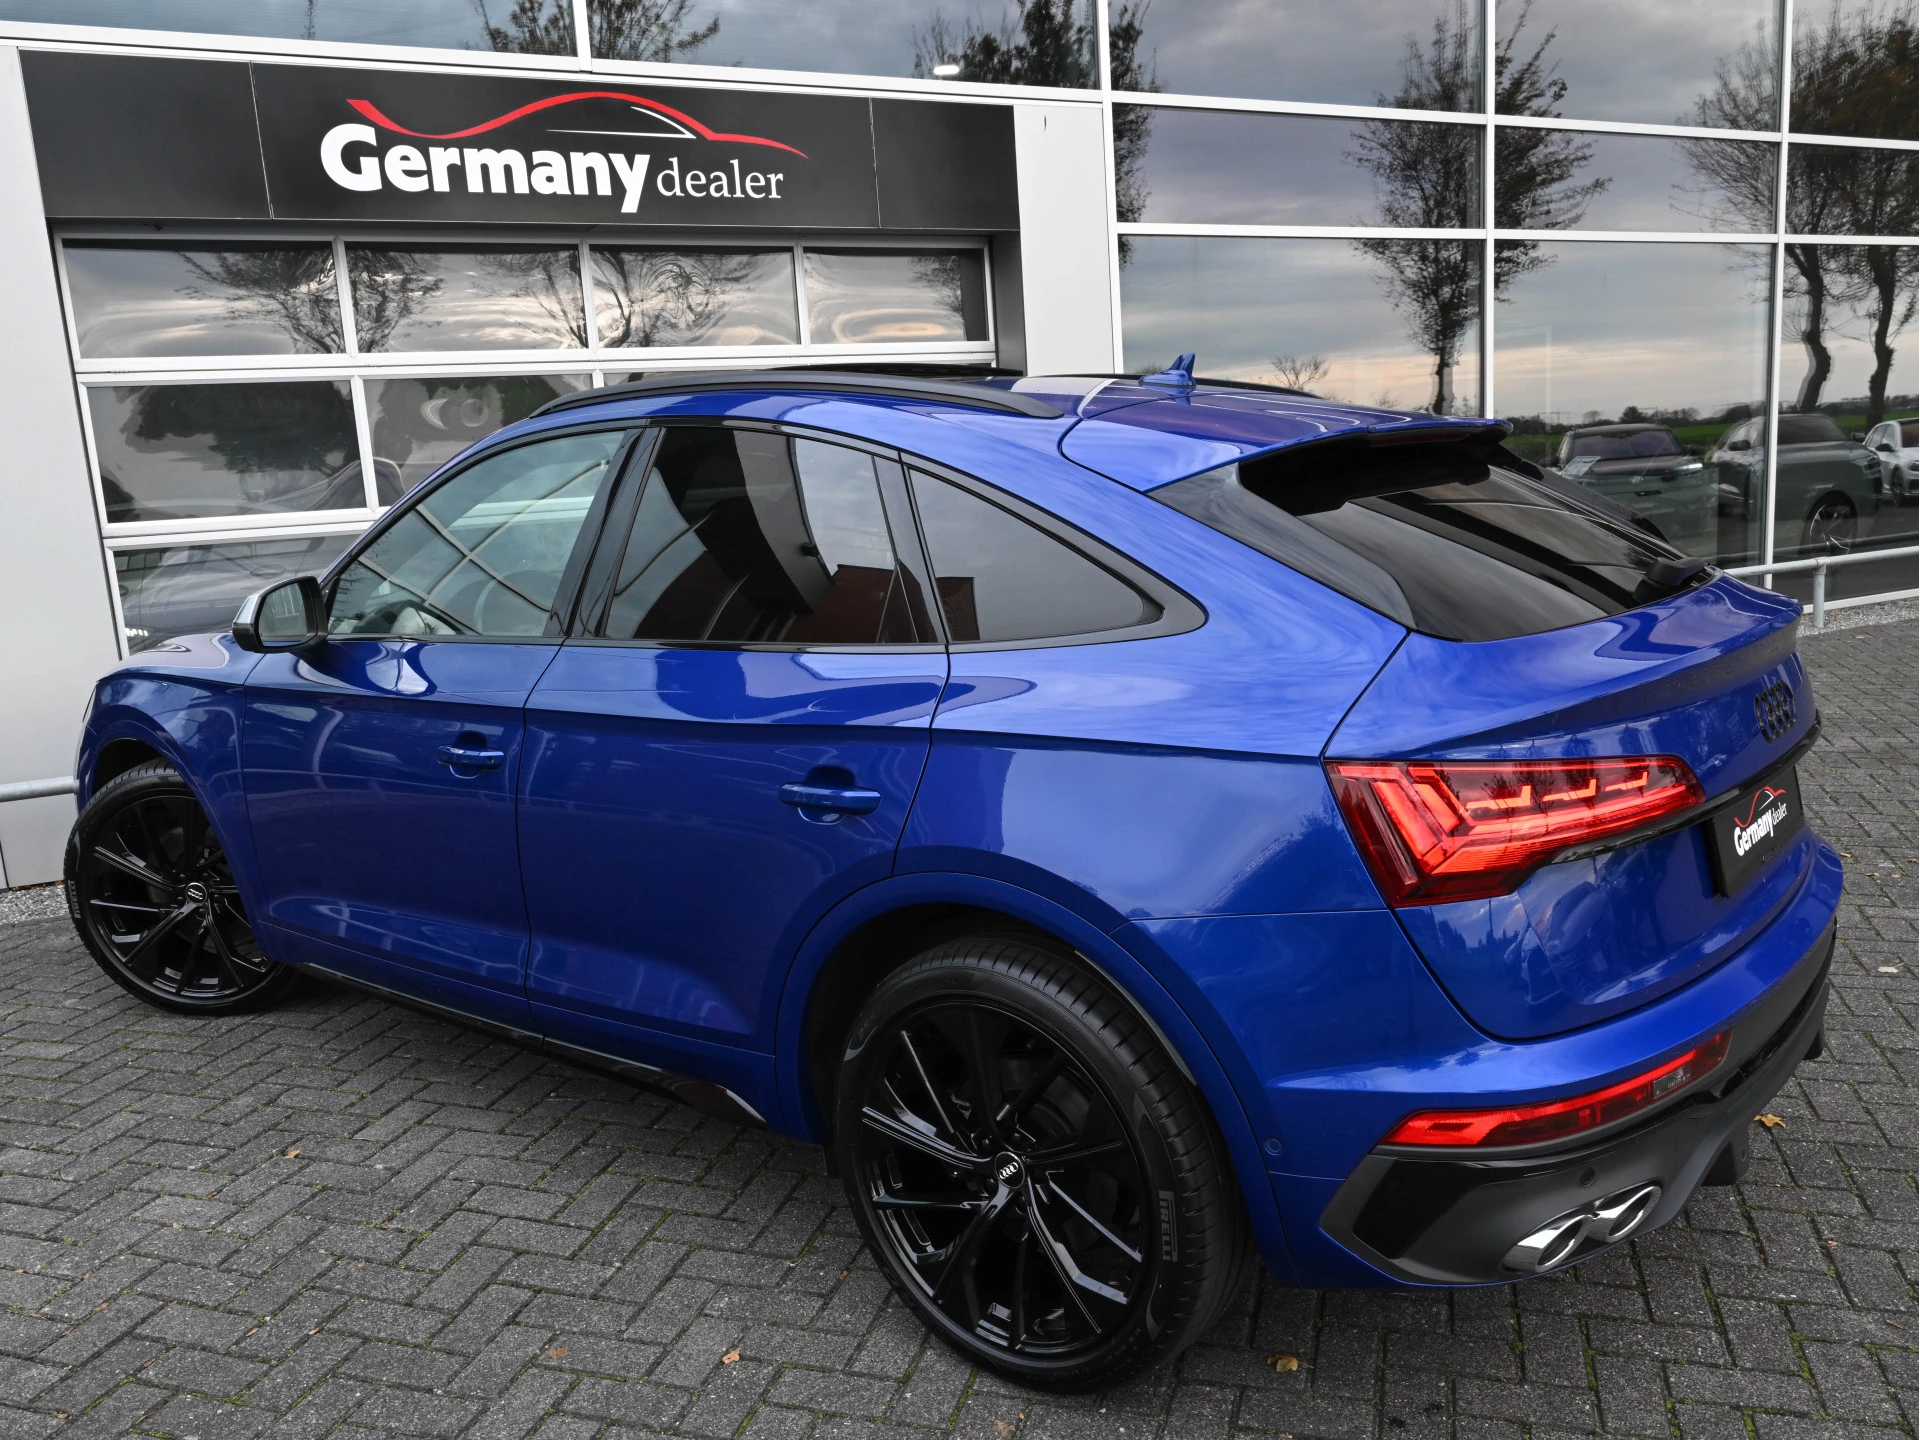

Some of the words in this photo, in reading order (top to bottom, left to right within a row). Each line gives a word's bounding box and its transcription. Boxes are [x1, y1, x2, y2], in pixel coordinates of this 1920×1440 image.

[320, 123, 650, 213] Germany
[656, 158, 784, 199] dealer
[1733, 809, 1774, 856] Germany
[1772, 801, 1788, 825] dealer
[1158, 1190, 1178, 1262] PIRELLI
